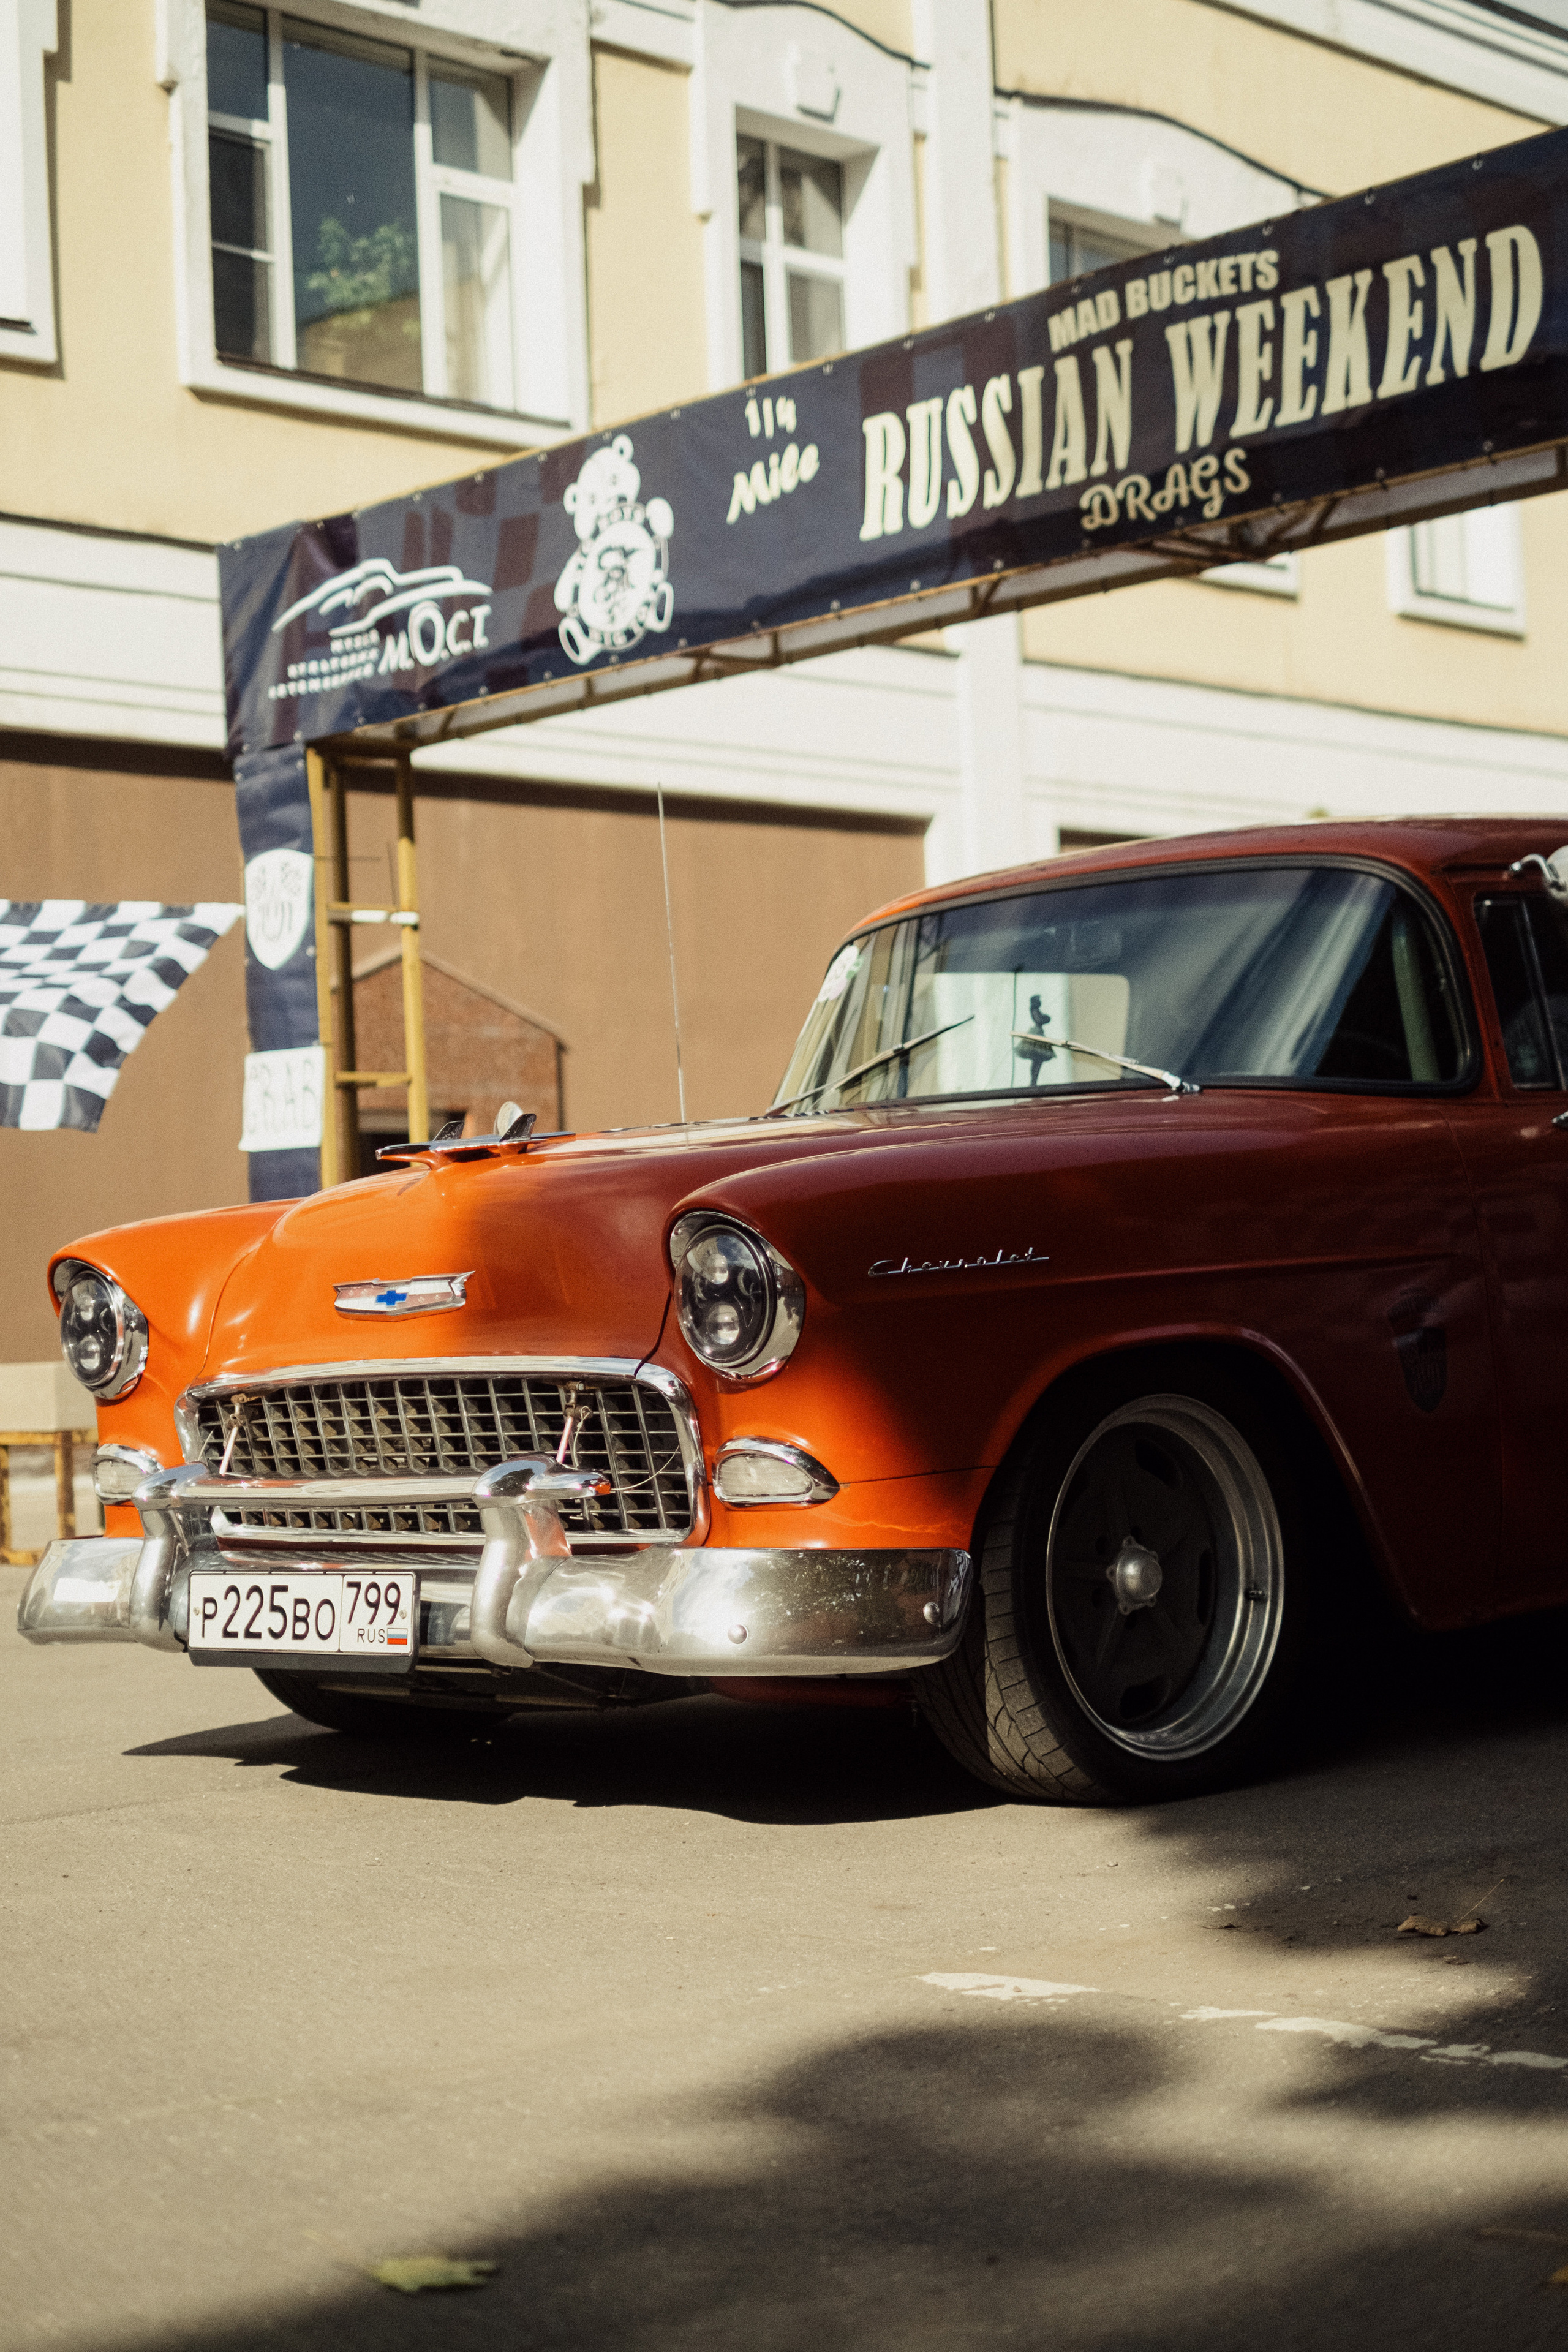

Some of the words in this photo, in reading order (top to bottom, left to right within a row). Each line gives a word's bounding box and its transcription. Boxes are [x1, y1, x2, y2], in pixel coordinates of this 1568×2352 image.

[1048, 290, 1120, 353] MAD
[1125, 249, 1279, 319] BUCKETS
[859, 339, 1132, 542] RUSSIAN
[1165, 225, 1544, 453] WEEKEND
[1079, 448, 1250, 530] DRAGS
[868, 1247, 1049, 1277] Chevrolet
[346, 1581, 401, 1626] 799
[356, 1627, 385, 1644] RUS
